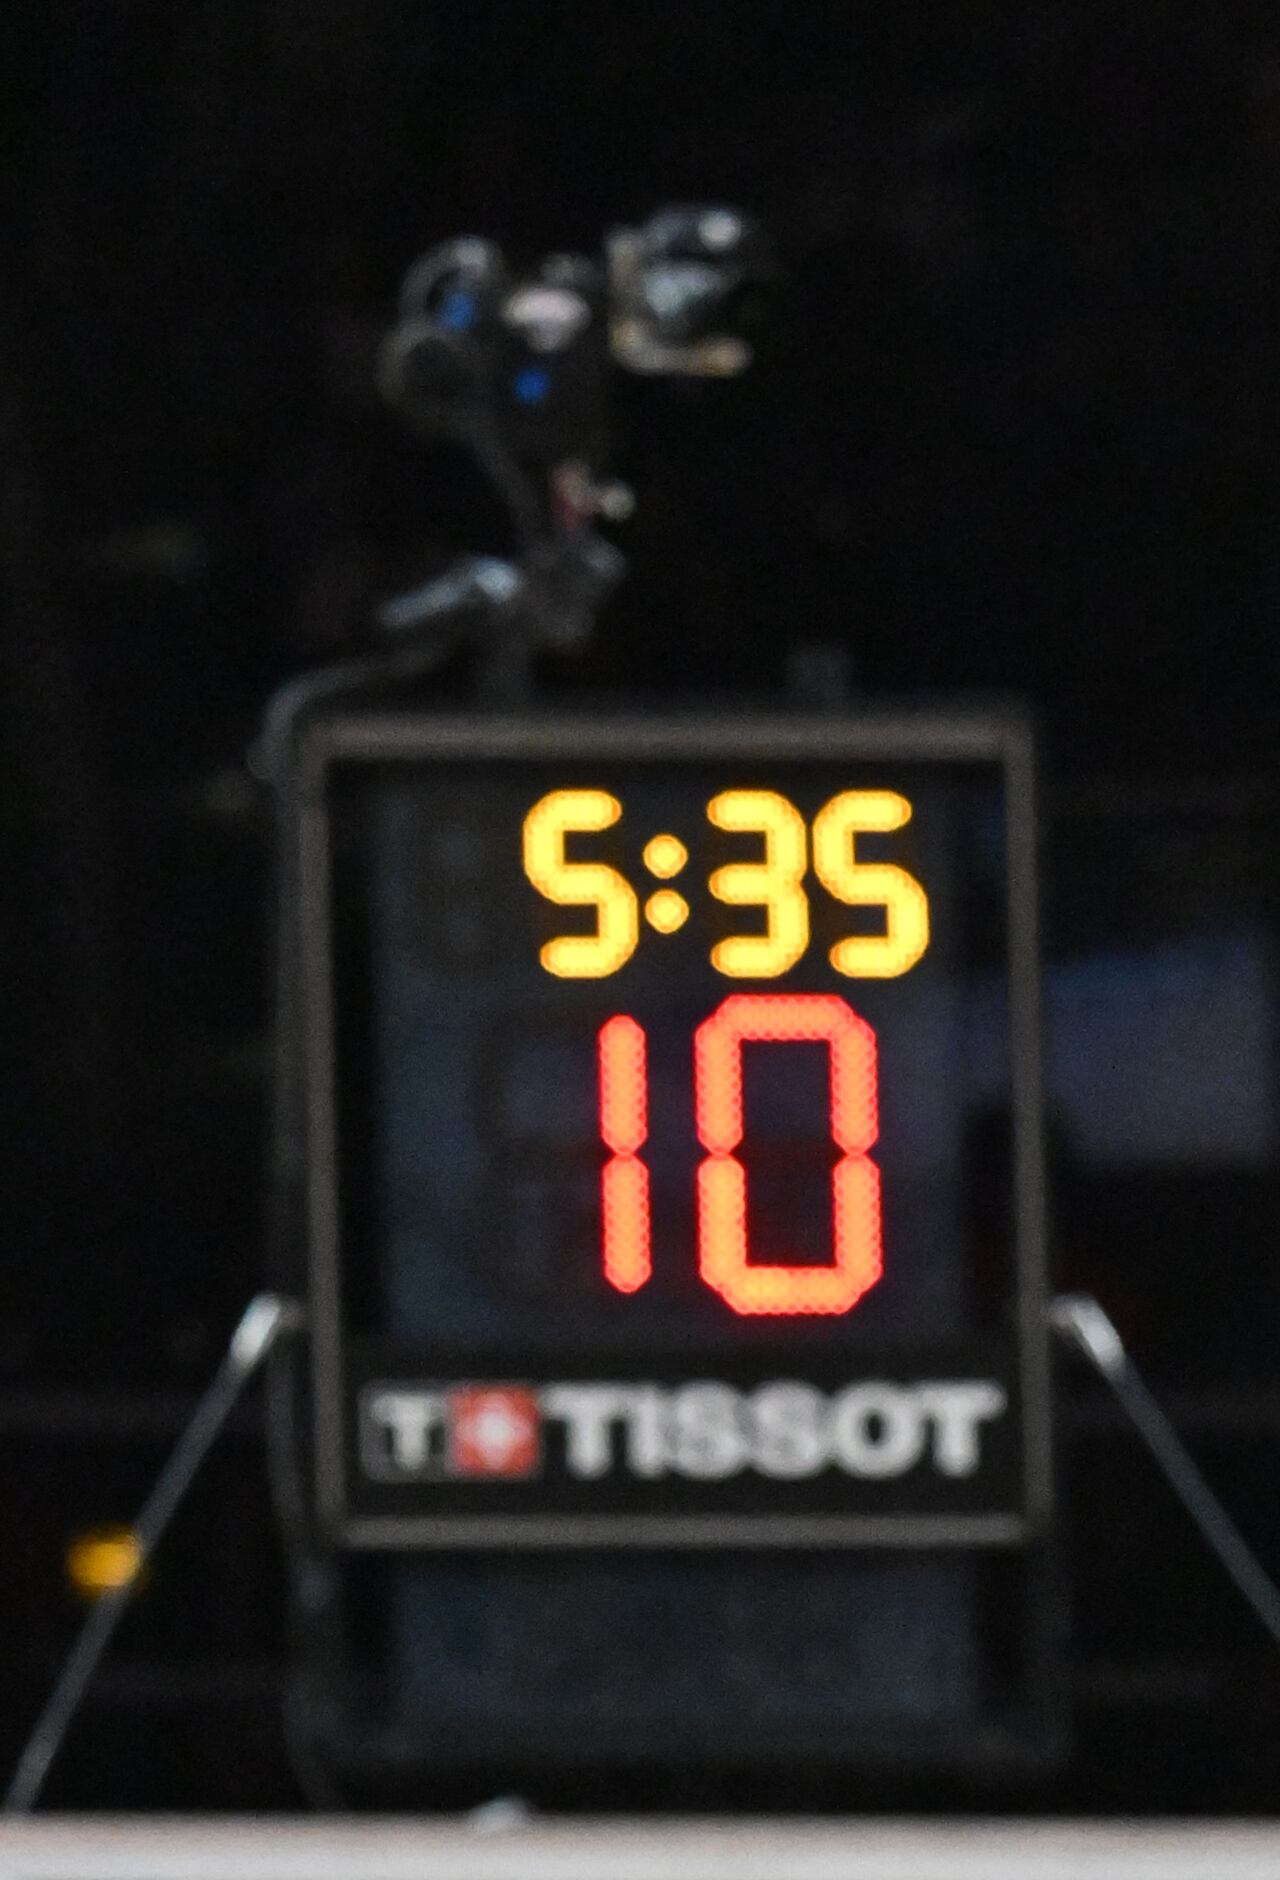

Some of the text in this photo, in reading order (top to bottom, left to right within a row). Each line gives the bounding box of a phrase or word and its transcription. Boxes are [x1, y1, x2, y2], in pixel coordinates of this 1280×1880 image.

[522, 788, 930, 979] 5:35
[598, 994, 884, 1316] 10
[545, 1381, 1004, 1478] TISSOT
